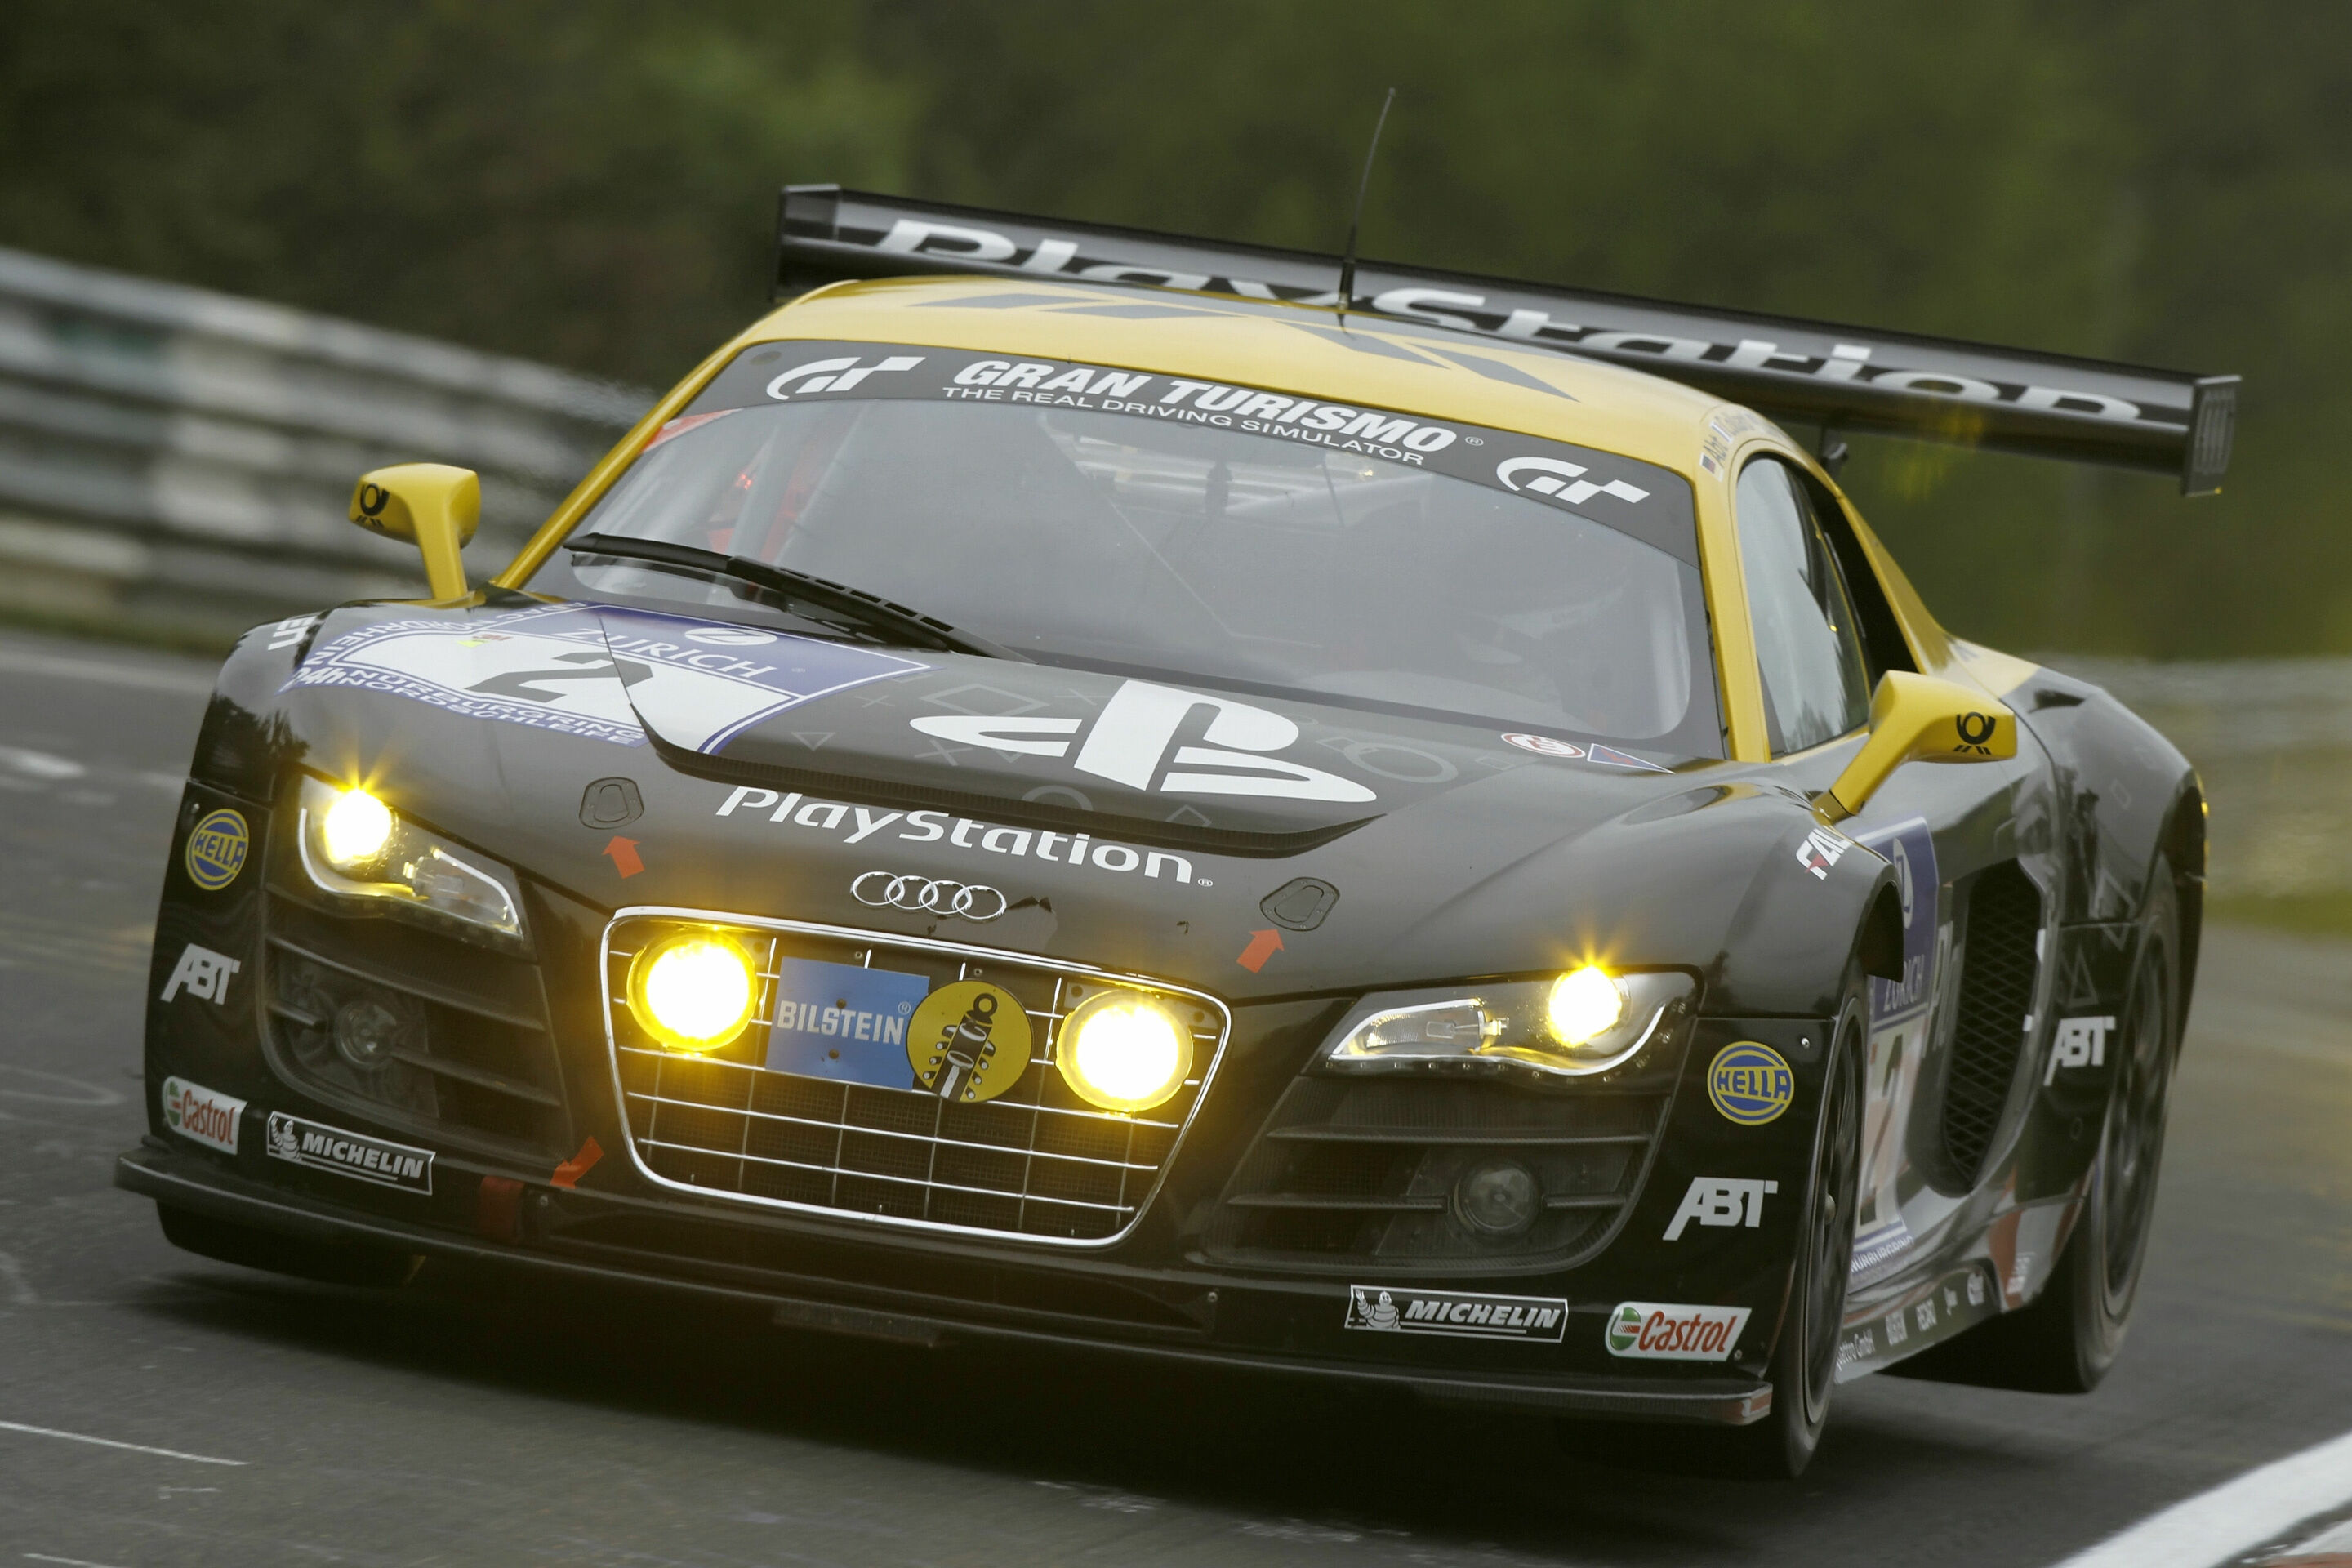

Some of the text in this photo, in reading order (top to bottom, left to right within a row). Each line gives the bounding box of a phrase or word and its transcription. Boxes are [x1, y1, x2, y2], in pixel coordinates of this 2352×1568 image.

[942, 387, 1425, 466] THE REAL DRIVING SIMULATOR
[954, 360, 1457, 452] GRAN TURISMO
[463, 652, 653, 703] 2
[557, 628, 777, 678] ZURICH
[338, 677, 635, 746] NORDSCHLEIFE
[193, 832, 246, 871] HELLA
[715, 786, 1192, 884] PlayStation
[160, 942, 241, 1005] ABT
[777, 1000, 904, 1046] BILSTEIN
[2044, 1016, 2116, 1086] ABT
[1716, 1064, 1793, 1099] HELLA
[183, 1089, 236, 1145] Castrol
[301, 1131, 425, 1178] MICHELIN
[1662, 1176, 1778, 1241] ABT
[1405, 1299, 1561, 1330] MICHELIN
[1637, 1309, 1738, 1353] Castrol
